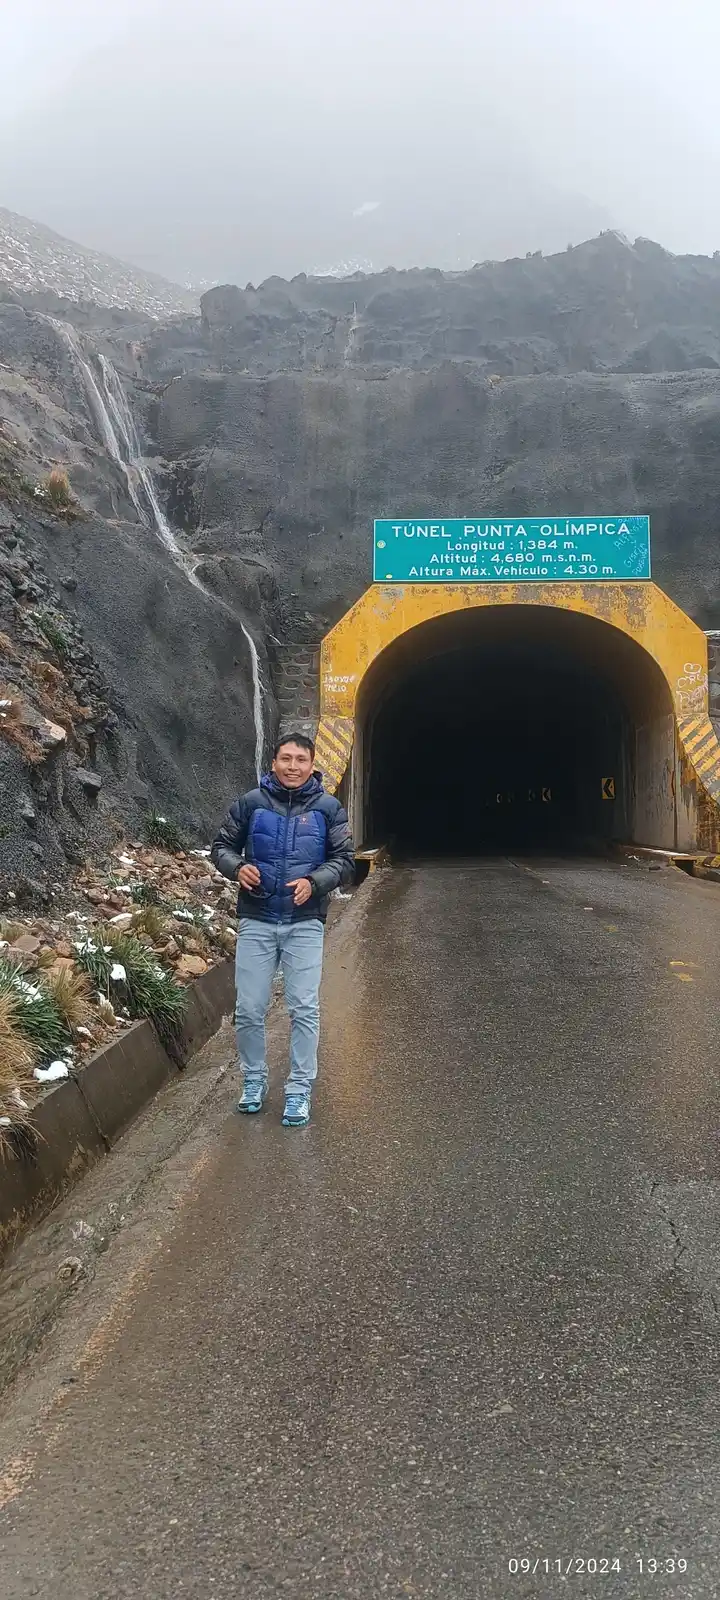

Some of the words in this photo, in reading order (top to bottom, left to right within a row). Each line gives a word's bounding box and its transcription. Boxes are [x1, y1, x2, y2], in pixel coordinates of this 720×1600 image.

[391, 522, 452, 538] TÚNEL
[464, 524, 528, 537] PUNTA
[540, 520, 631, 536] OLÍMPICA
[447, 540, 505, 553] Longitud
[519, 540, 558, 551] 1,384
[563, 541, 578, 549] m.
[429, 553, 477, 563] Altitud
[490, 553, 535, 564] 4,680
[541, 553, 596, 562] m.s.n.m.
[408, 566, 453, 577] Altura
[460, 564, 491, 576] Máx.
[493, 565, 548, 576] Vehículo
[563, 564, 598, 575] 4.30
[602, 566, 617, 574] m.
